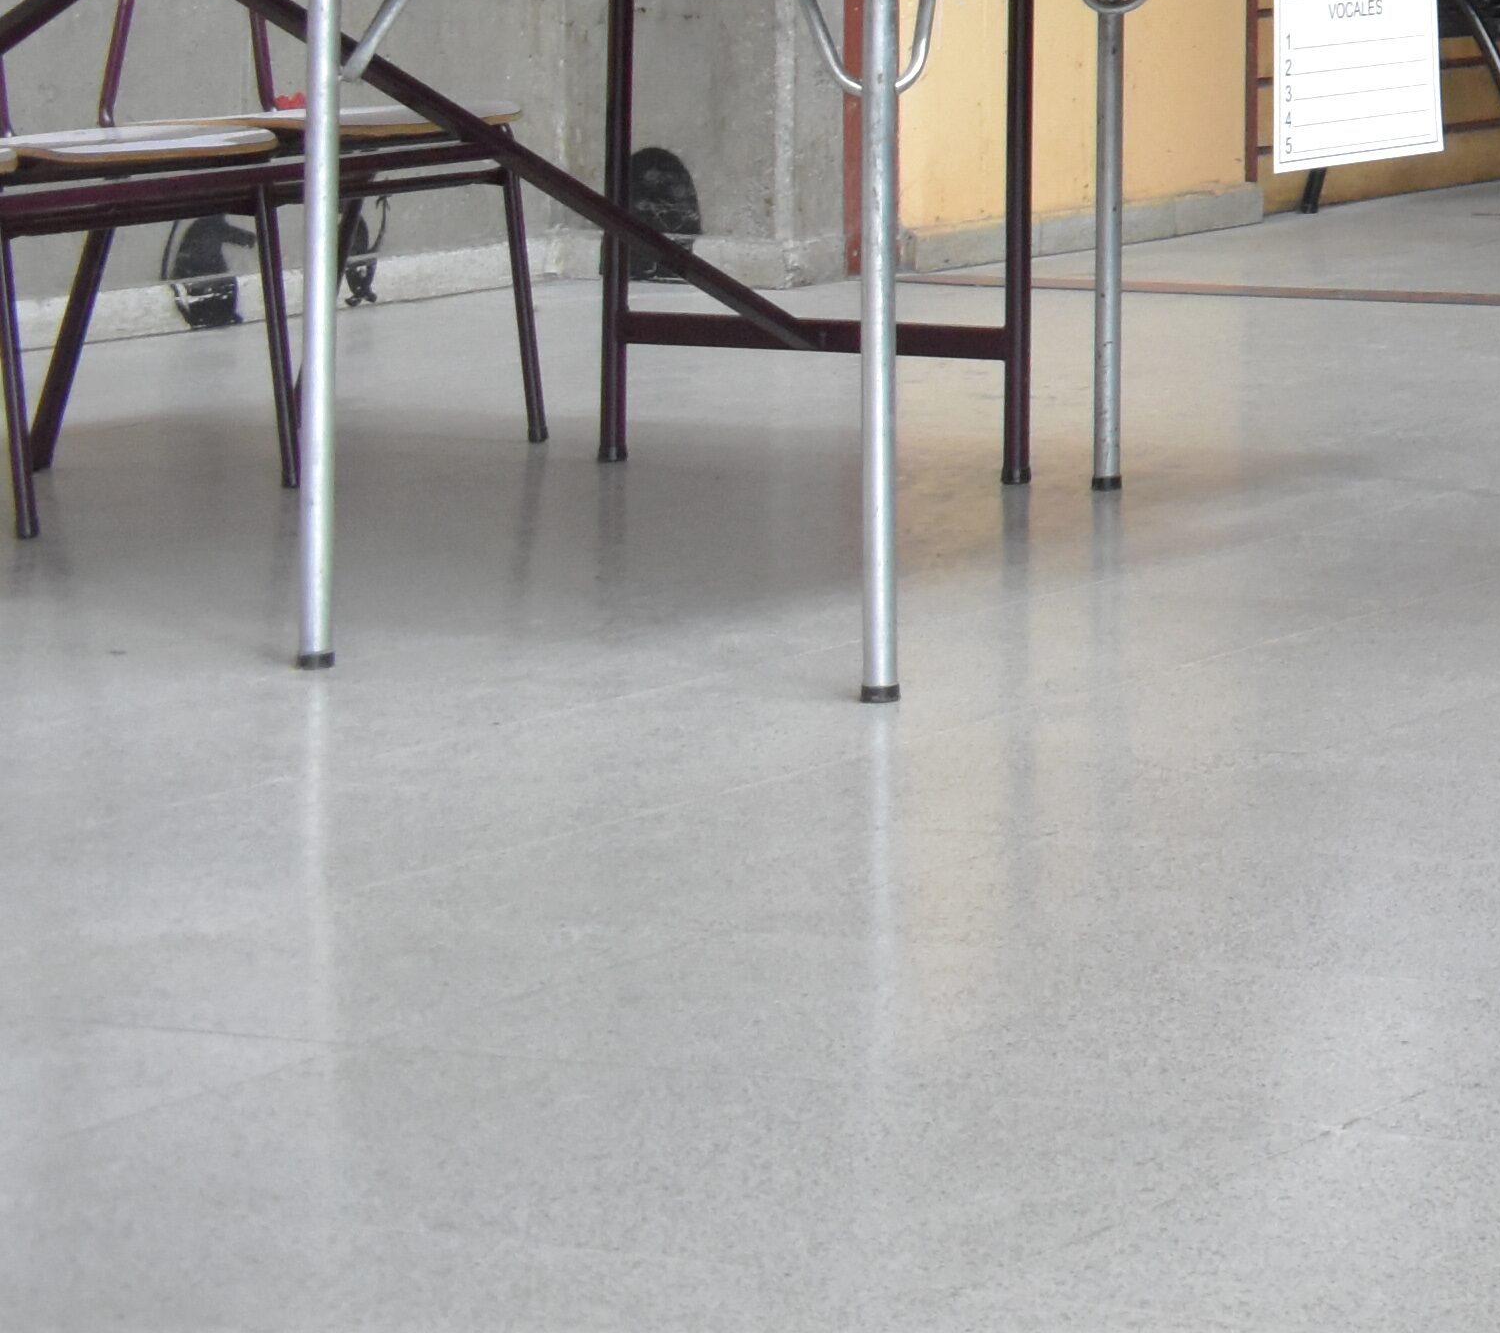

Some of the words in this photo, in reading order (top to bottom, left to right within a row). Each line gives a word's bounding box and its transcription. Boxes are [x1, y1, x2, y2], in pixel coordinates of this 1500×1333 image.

[1285, 34, 1292, 51] 1
[1285, 59, 1292, 77] 2
[1285, 85, 1292, 102] 3
[1285, 111, 1292, 128] 4
[1285, 137, 1292, 155] 5
